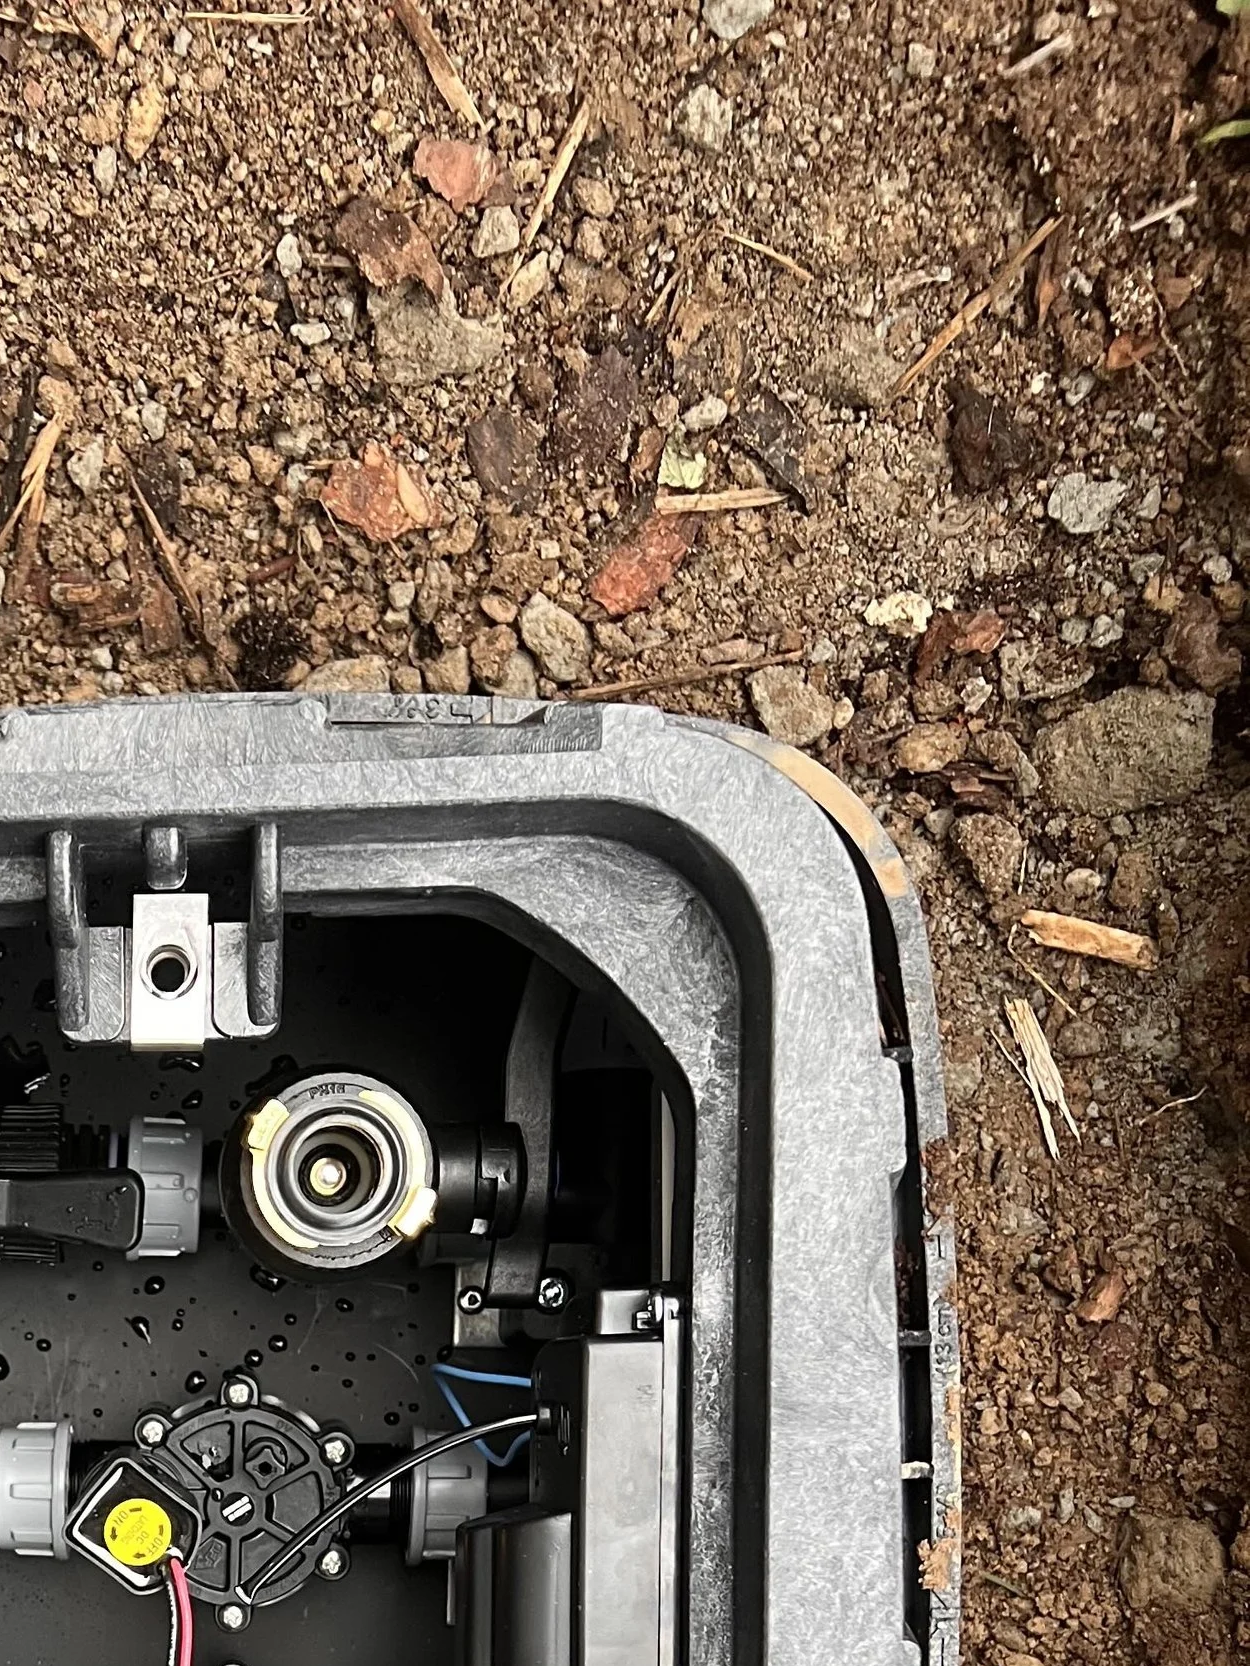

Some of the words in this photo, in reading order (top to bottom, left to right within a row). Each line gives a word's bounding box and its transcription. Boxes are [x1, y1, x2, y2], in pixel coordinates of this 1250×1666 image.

[307, 1083, 347, 1099] PN16
[113, 1510, 129, 1526] ON
[136, 1530, 150, 1545] DC
[146, 1536, 164, 1557] OFF
